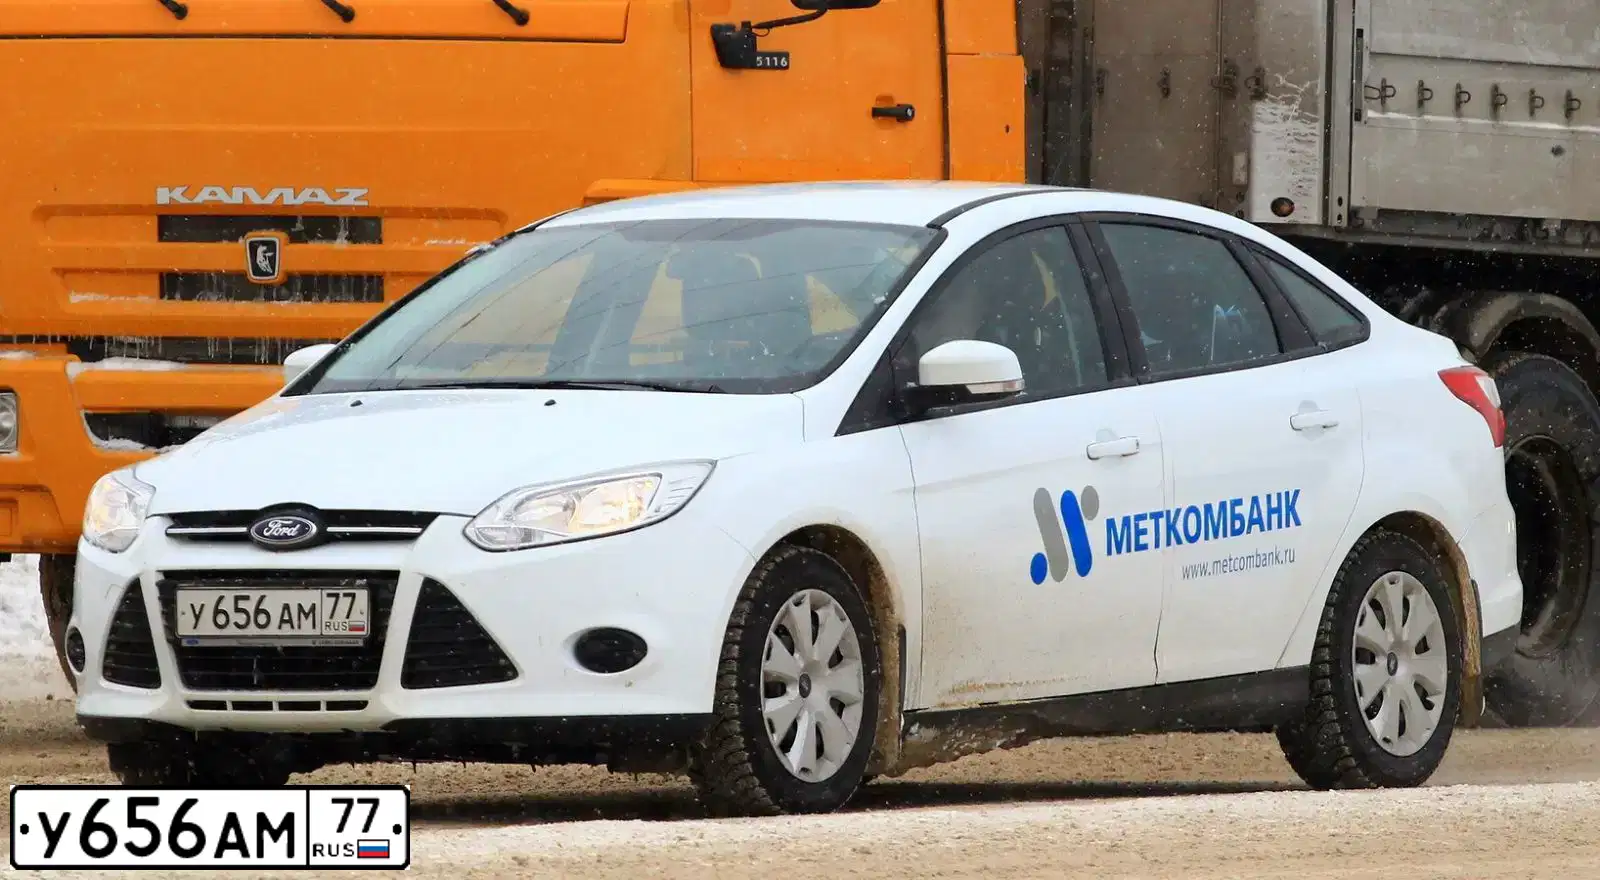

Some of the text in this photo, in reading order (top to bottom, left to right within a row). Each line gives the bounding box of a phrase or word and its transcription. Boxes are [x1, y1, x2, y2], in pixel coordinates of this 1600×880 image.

[156, 185, 369, 206] KAMAZ
[263, 519, 301, 537] Ford
[1106, 488, 1302, 557] МЕТКОМБАНК
[1181, 547, 1296, 580] www.metcombank.ru
[325, 592, 357, 620] 77
[324, 621, 348, 632] RUS
